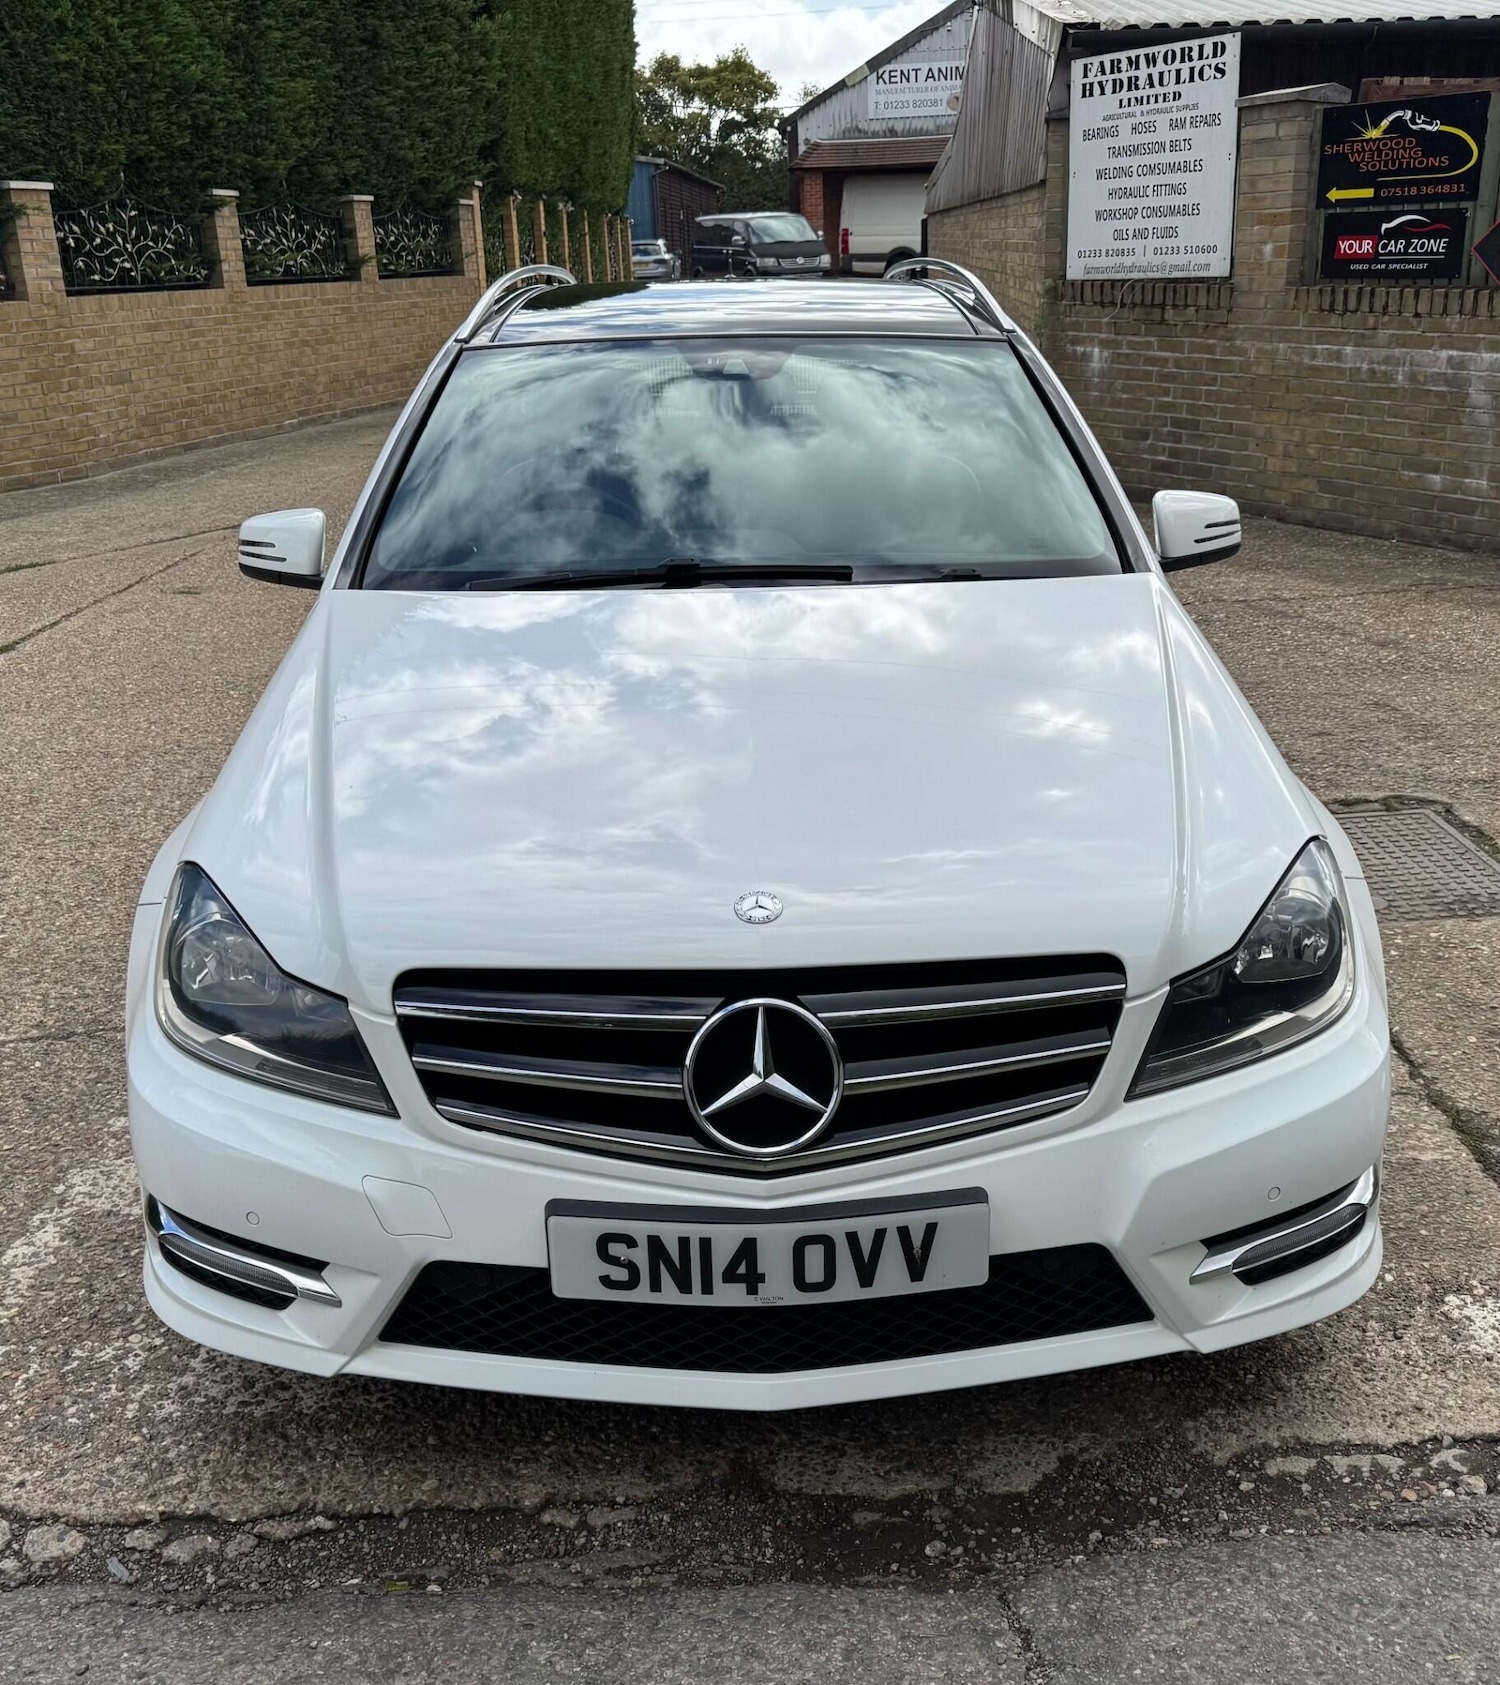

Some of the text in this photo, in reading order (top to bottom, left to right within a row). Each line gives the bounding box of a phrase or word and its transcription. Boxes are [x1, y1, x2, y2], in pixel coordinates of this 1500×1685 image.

[1082, 40, 1227, 79] FARMWORLD
[876, 68, 921, 85] KENT
[1081, 62, 1226, 99] HYDRAULICS
[875, 87, 930, 96] MANUFACTURER
[930, 85, 939, 93] OF
[874, 98, 943, 111] T: 01233 820381
[1118, 91, 1182, 109] LIMITED
[1102, 102, 1199, 122] AGRICULTURAL & HYDRAULIC SUPPLIES
[1082, 113, 1222, 142] BEARINGS HOSES RAM REPAIRS
[1107, 138, 1192, 159] TRANSMISSION BELTS
[1324, 137, 1416, 155] SHERWOOD
[1348, 147, 1422, 163] WELDING
[1096, 159, 1203, 181] WELDING COMSUMABLES
[1358, 156, 1450, 172] SOLUTIONS
[1107, 182, 1187, 200] HYDRAULIC FITTINGS
[1380, 183, 1466, 197] 07518 364831
[1095, 203, 1201, 222] WORKSHOP CONSUMABLES
[1113, 226, 1179, 241] OILS AND FLUIDS
[1077, 249, 1103, 258] 01233
[1104, 247, 1136, 257] 820835
[1153, 246, 1180, 256] 01233
[1184, 244, 1218, 255] 510600
[1338, 238, 1449, 254] YOUR CAR ZONE
[1083, 260, 1211, 276] farmworldhydraulics@gmail.com
[596, 1221, 939, 1296] SN14 OVV
